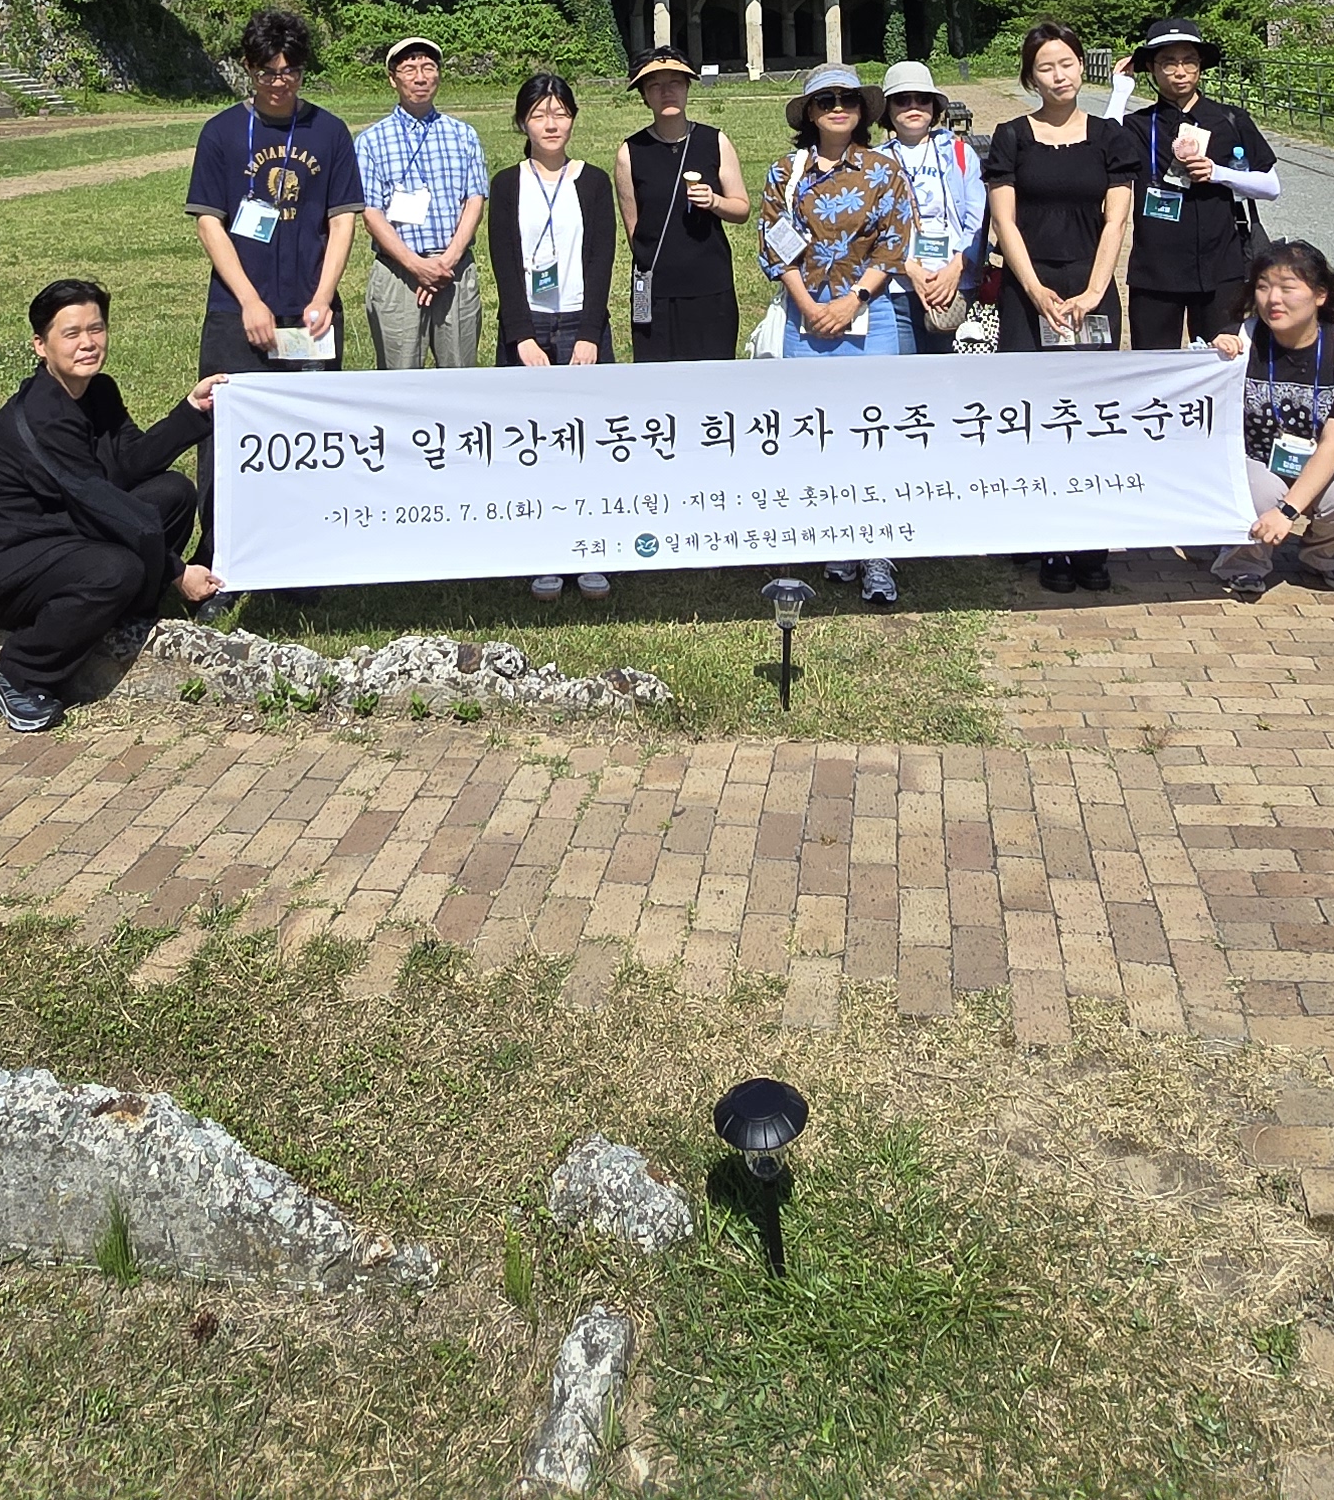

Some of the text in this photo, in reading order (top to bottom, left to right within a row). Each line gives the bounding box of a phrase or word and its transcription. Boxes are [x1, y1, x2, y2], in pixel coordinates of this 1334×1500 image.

[244, 145, 322, 178] INDIAN LAKE
[239, 394, 1216, 474] 2025년 일제강제동원 희생자 유족 국외추도순례
[395, 504, 451, 525] 2025.
[459, 503, 478, 522] 7.
[486, 498, 543, 521] 8.(화)
[574, 498, 593, 516] 7.
[601, 493, 670, 516] 14.(월)
[751, 488, 790, 510] 일본
[798, 484, 888, 508] 홋카이도,
[894, 481, 962, 503] 니가타,
[1065, 473, 1146, 496] 오키나와
[571, 538, 606, 558] 주최
[664, 522, 917, 554] 일제강제동원피해자지원재단
